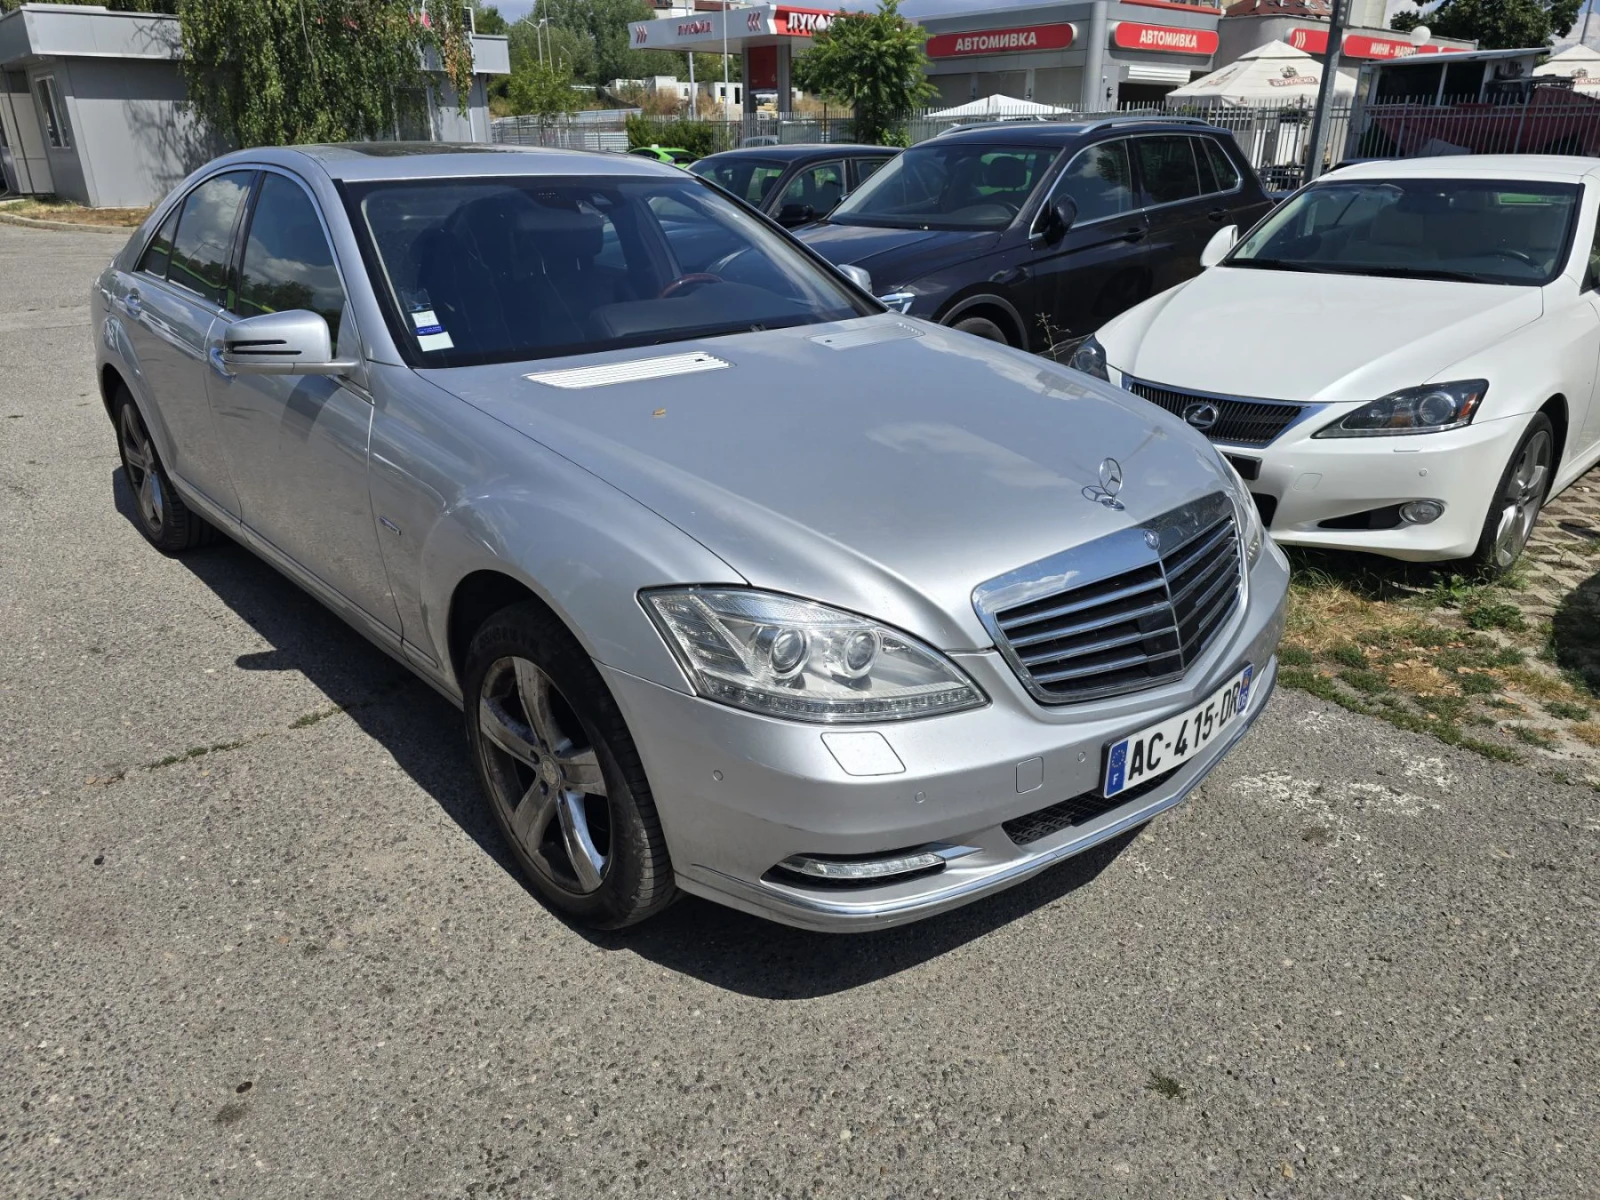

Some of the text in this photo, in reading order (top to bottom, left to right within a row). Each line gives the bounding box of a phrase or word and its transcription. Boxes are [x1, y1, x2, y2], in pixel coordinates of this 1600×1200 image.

[787, 12, 846, 31] ЛУКОЙ
[955, 31, 1037, 51] АВТОМИВКА
[1139, 29, 1198, 48] АВТОМИВКА
[1128, 681, 1241, 781] AC-415-DR
[1112, 773, 1119, 786] F
